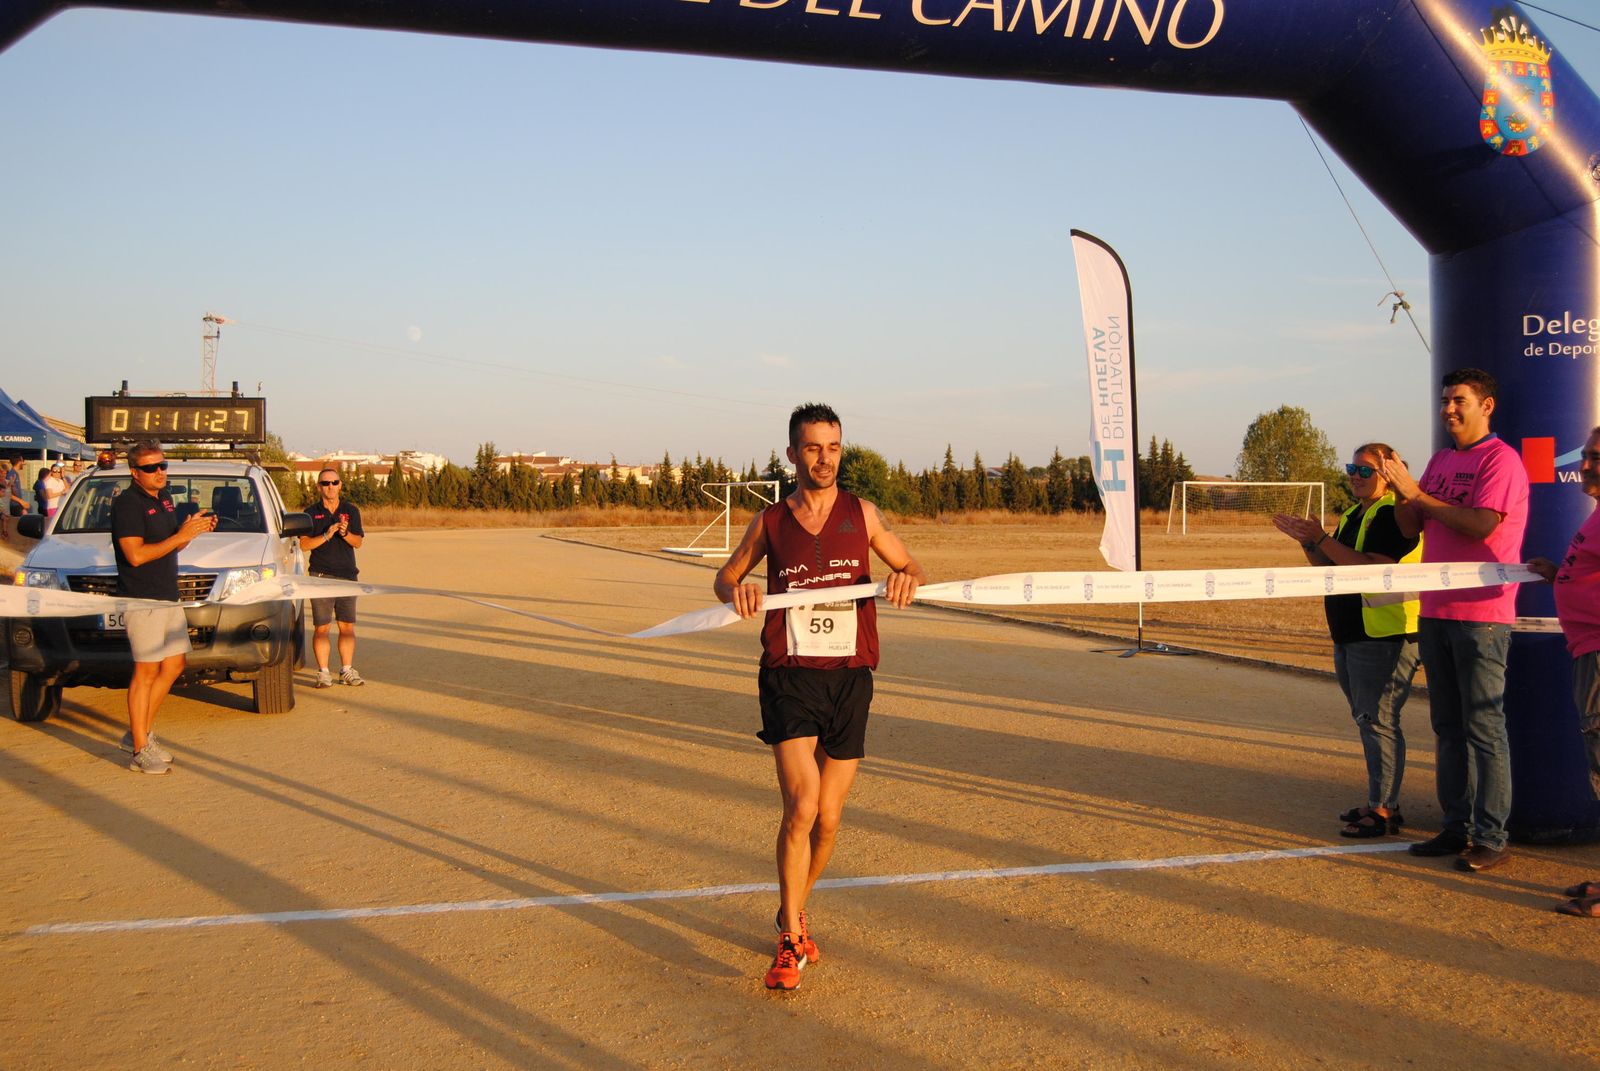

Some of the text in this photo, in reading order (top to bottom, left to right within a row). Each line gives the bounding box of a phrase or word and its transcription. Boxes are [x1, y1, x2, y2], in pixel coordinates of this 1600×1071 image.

[1523, 342, 1544, 357] de
[4, 435, 33, 443] CAMINO
[778, 558, 860, 578] ANA DIAS
[788, 572, 852, 589] RUNNERS
[809, 617, 834, 634] 59
